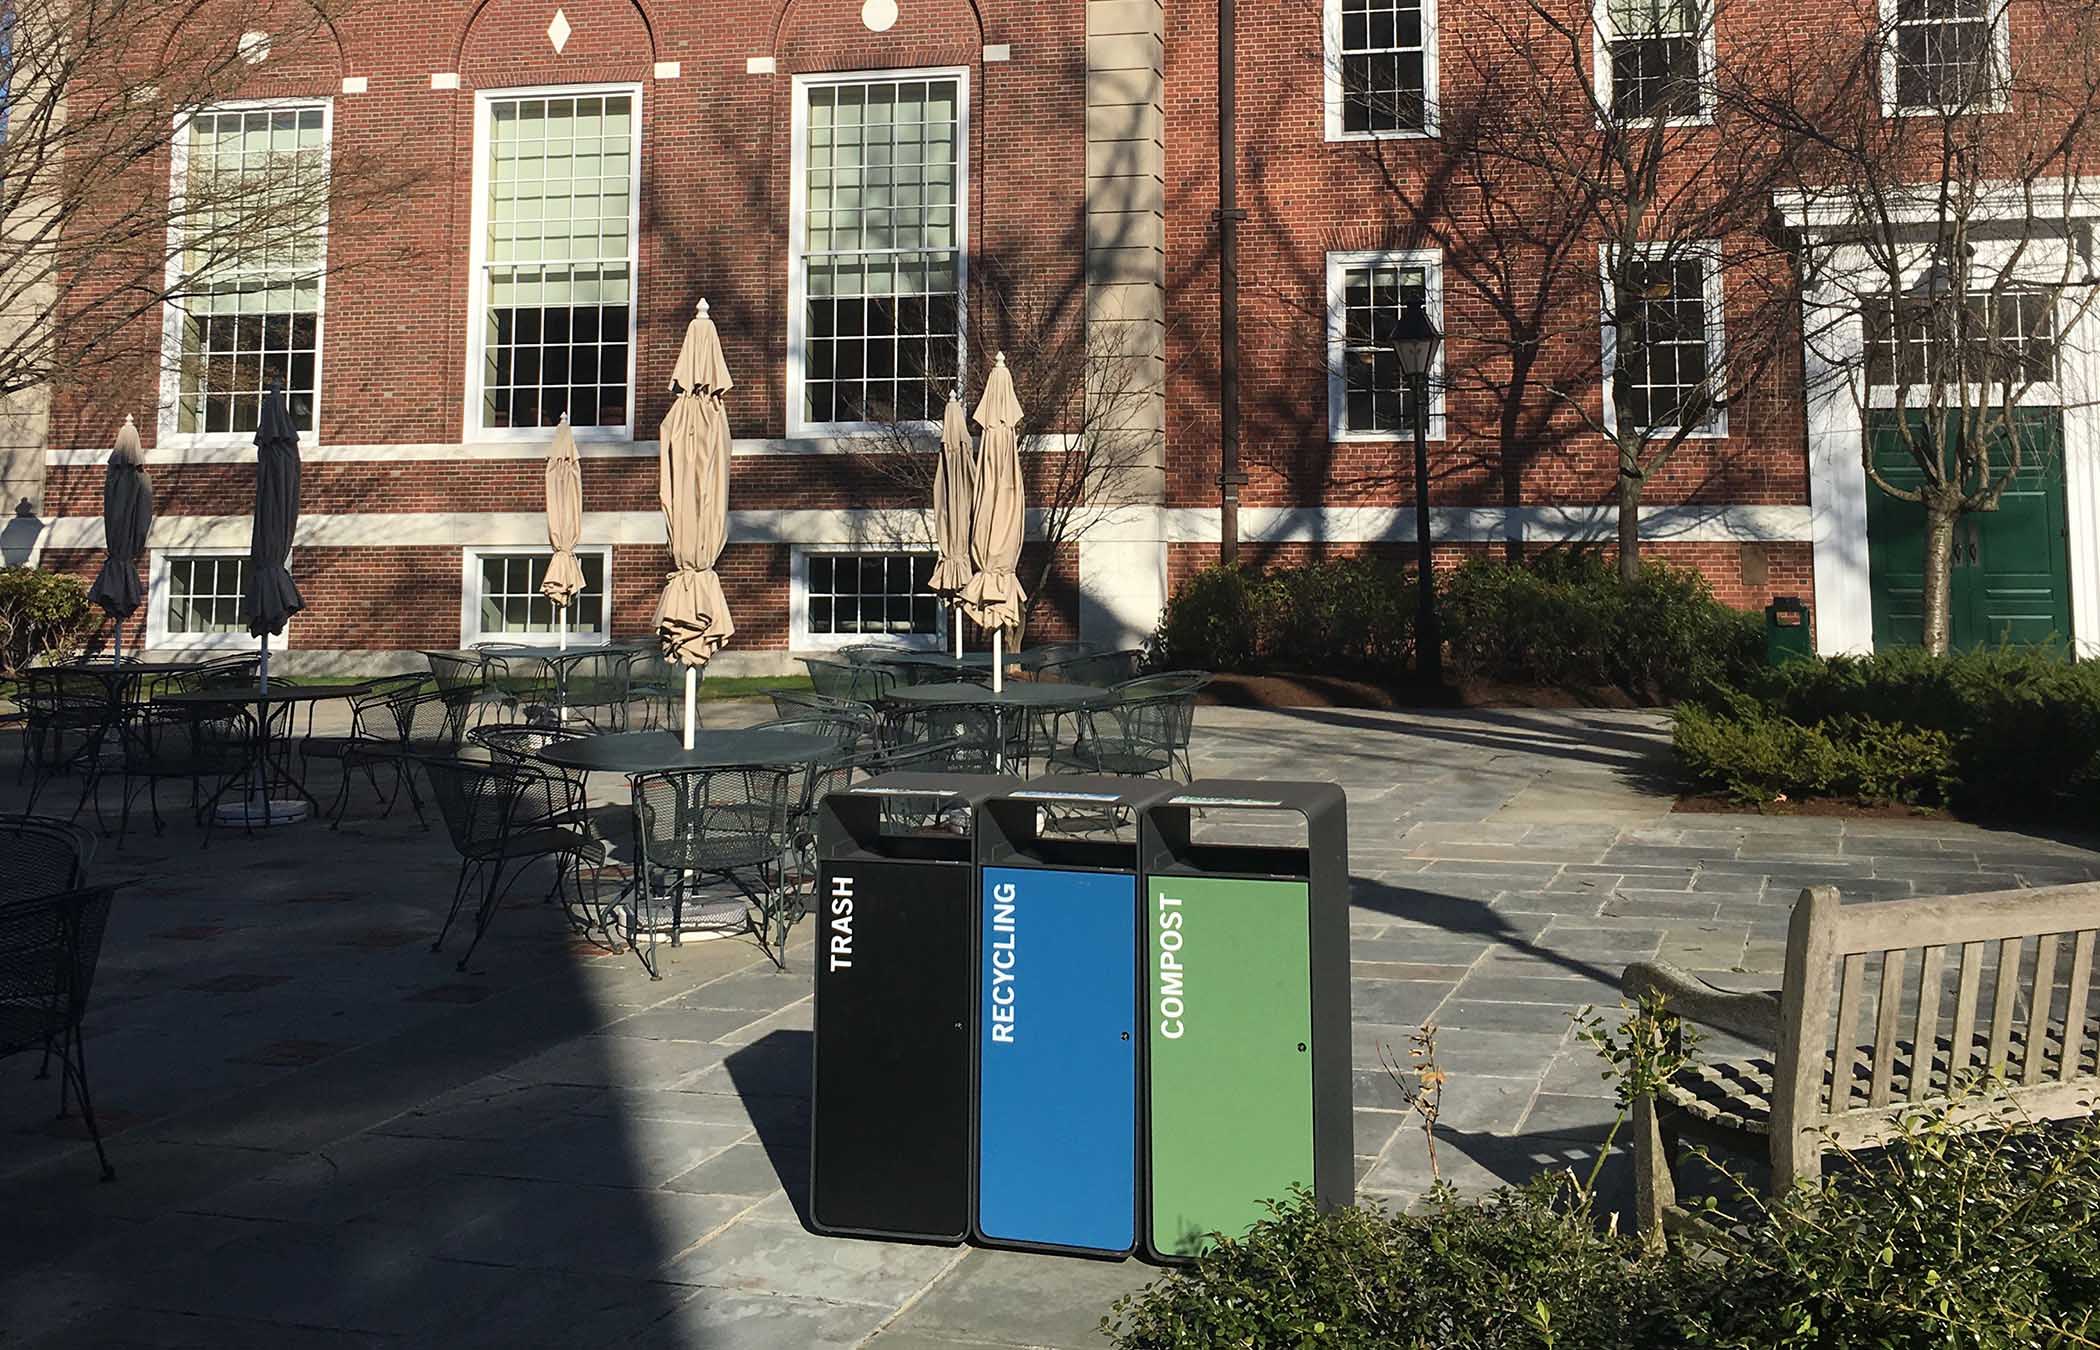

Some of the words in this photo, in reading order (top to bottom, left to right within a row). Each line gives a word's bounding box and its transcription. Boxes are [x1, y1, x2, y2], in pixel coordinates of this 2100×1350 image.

[830, 877, 854, 972] TRASH
[992, 883, 1016, 1043] RECYCLING
[1159, 892, 1185, 1039] COMPOST
